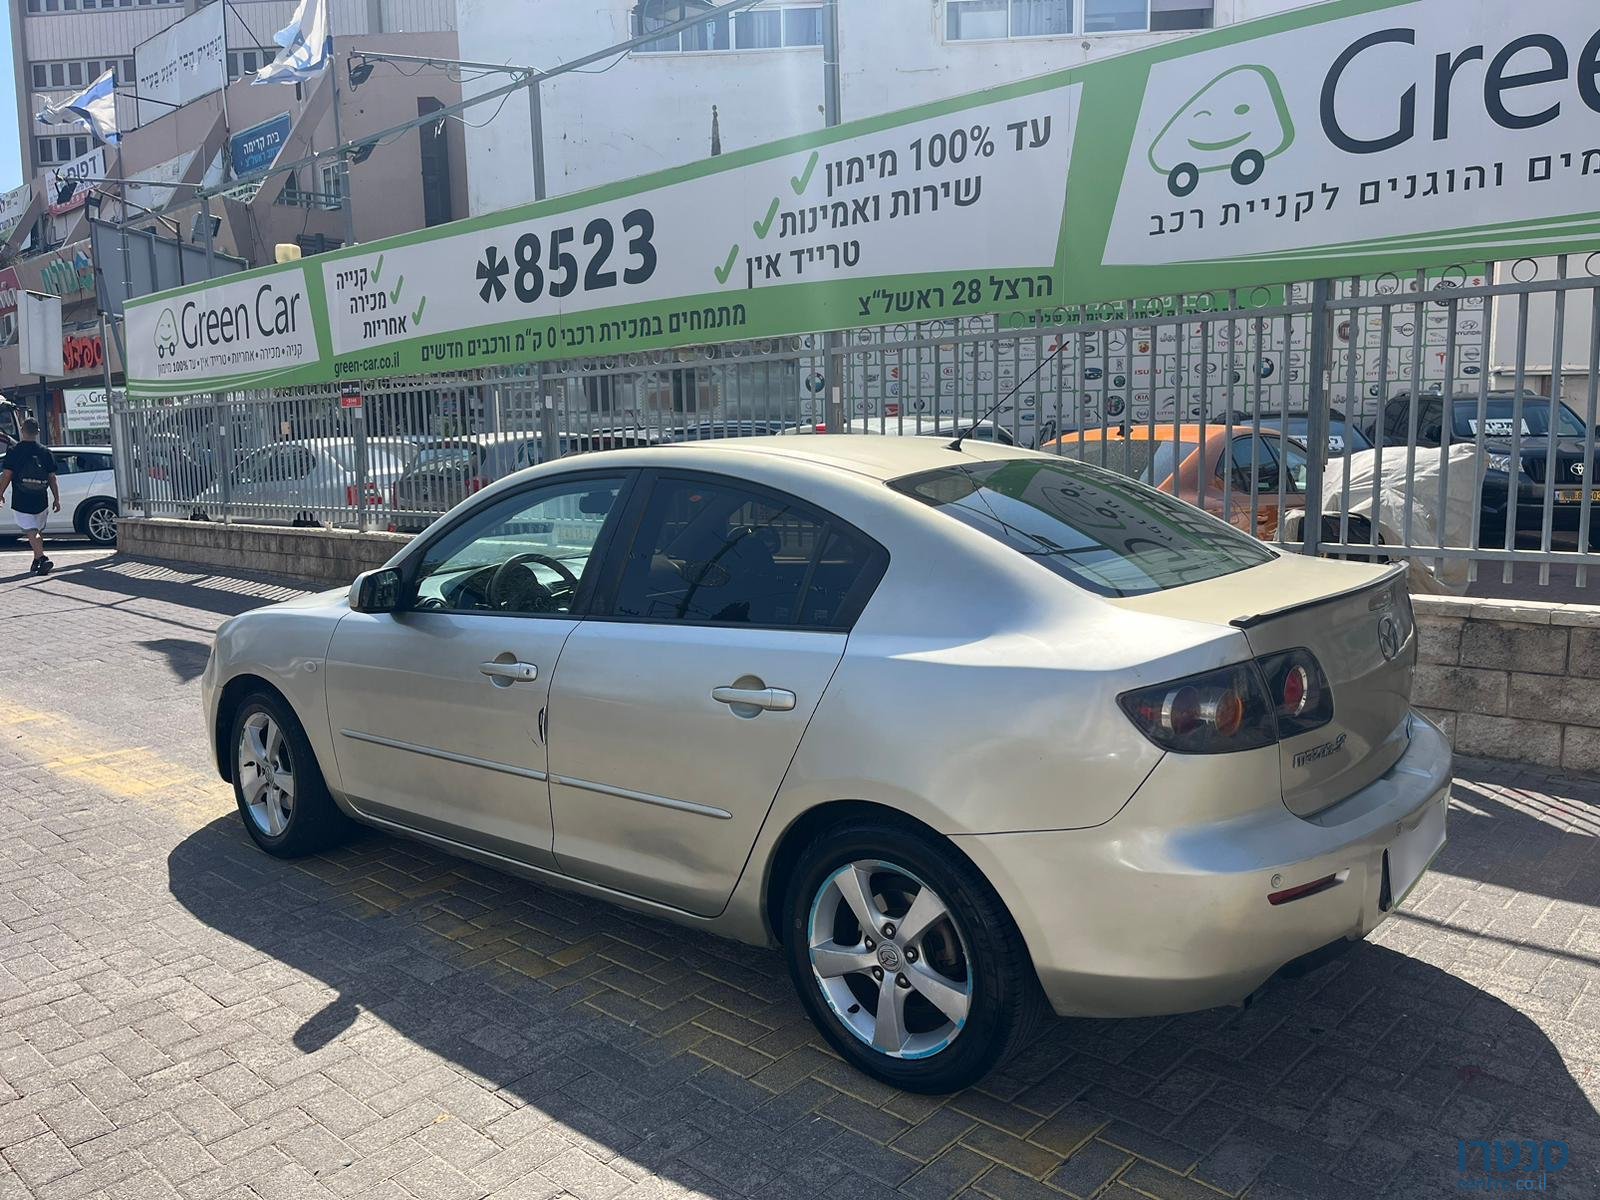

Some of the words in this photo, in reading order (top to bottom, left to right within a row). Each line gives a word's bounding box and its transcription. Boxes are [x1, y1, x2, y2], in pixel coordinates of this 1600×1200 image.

[1319, 27, 1600, 154] Gre
[1007, 115, 1051, 151] עד
[910, 125, 995, 172] 100%
[825, 149, 897, 197] מימון
[1359, 162, 1503, 205] והוגנים
[890, 175, 982, 219] שירות
[1218, 183, 1340, 227] לקניית
[779, 195, 881, 238] ואמינות
[1148, 208, 1205, 236] רכב
[746, 253, 782, 289] אין
[790, 240, 860, 275] טרייד
[336, 268, 368, 291] קנייה
[952, 279, 982, 306] 28
[988, 274, 1053, 301] הרצל
[350, 291, 387, 314] מכירה
[858, 287, 945, 316] ראשל"צ
[181, 301, 250, 349] Green
[255, 284, 300, 336] Car
[363, 315, 407, 339] אחריות
[599, 315, 663, 342] במכירת
[669, 303, 746, 333] מתמחים
[467, 335, 511, 357] ורכבים
[547, 327, 557, 348] 0
[561, 325, 595, 347] רכבי
[231, 350, 255, 364] אחריות
[259, 347, 280, 360] מכירה
[286, 344, 303, 359] קניה
[334, 351, 400, 378] green-car.co.il
[421, 341, 463, 362] חדשים
[172, 361, 189, 373] 100%
